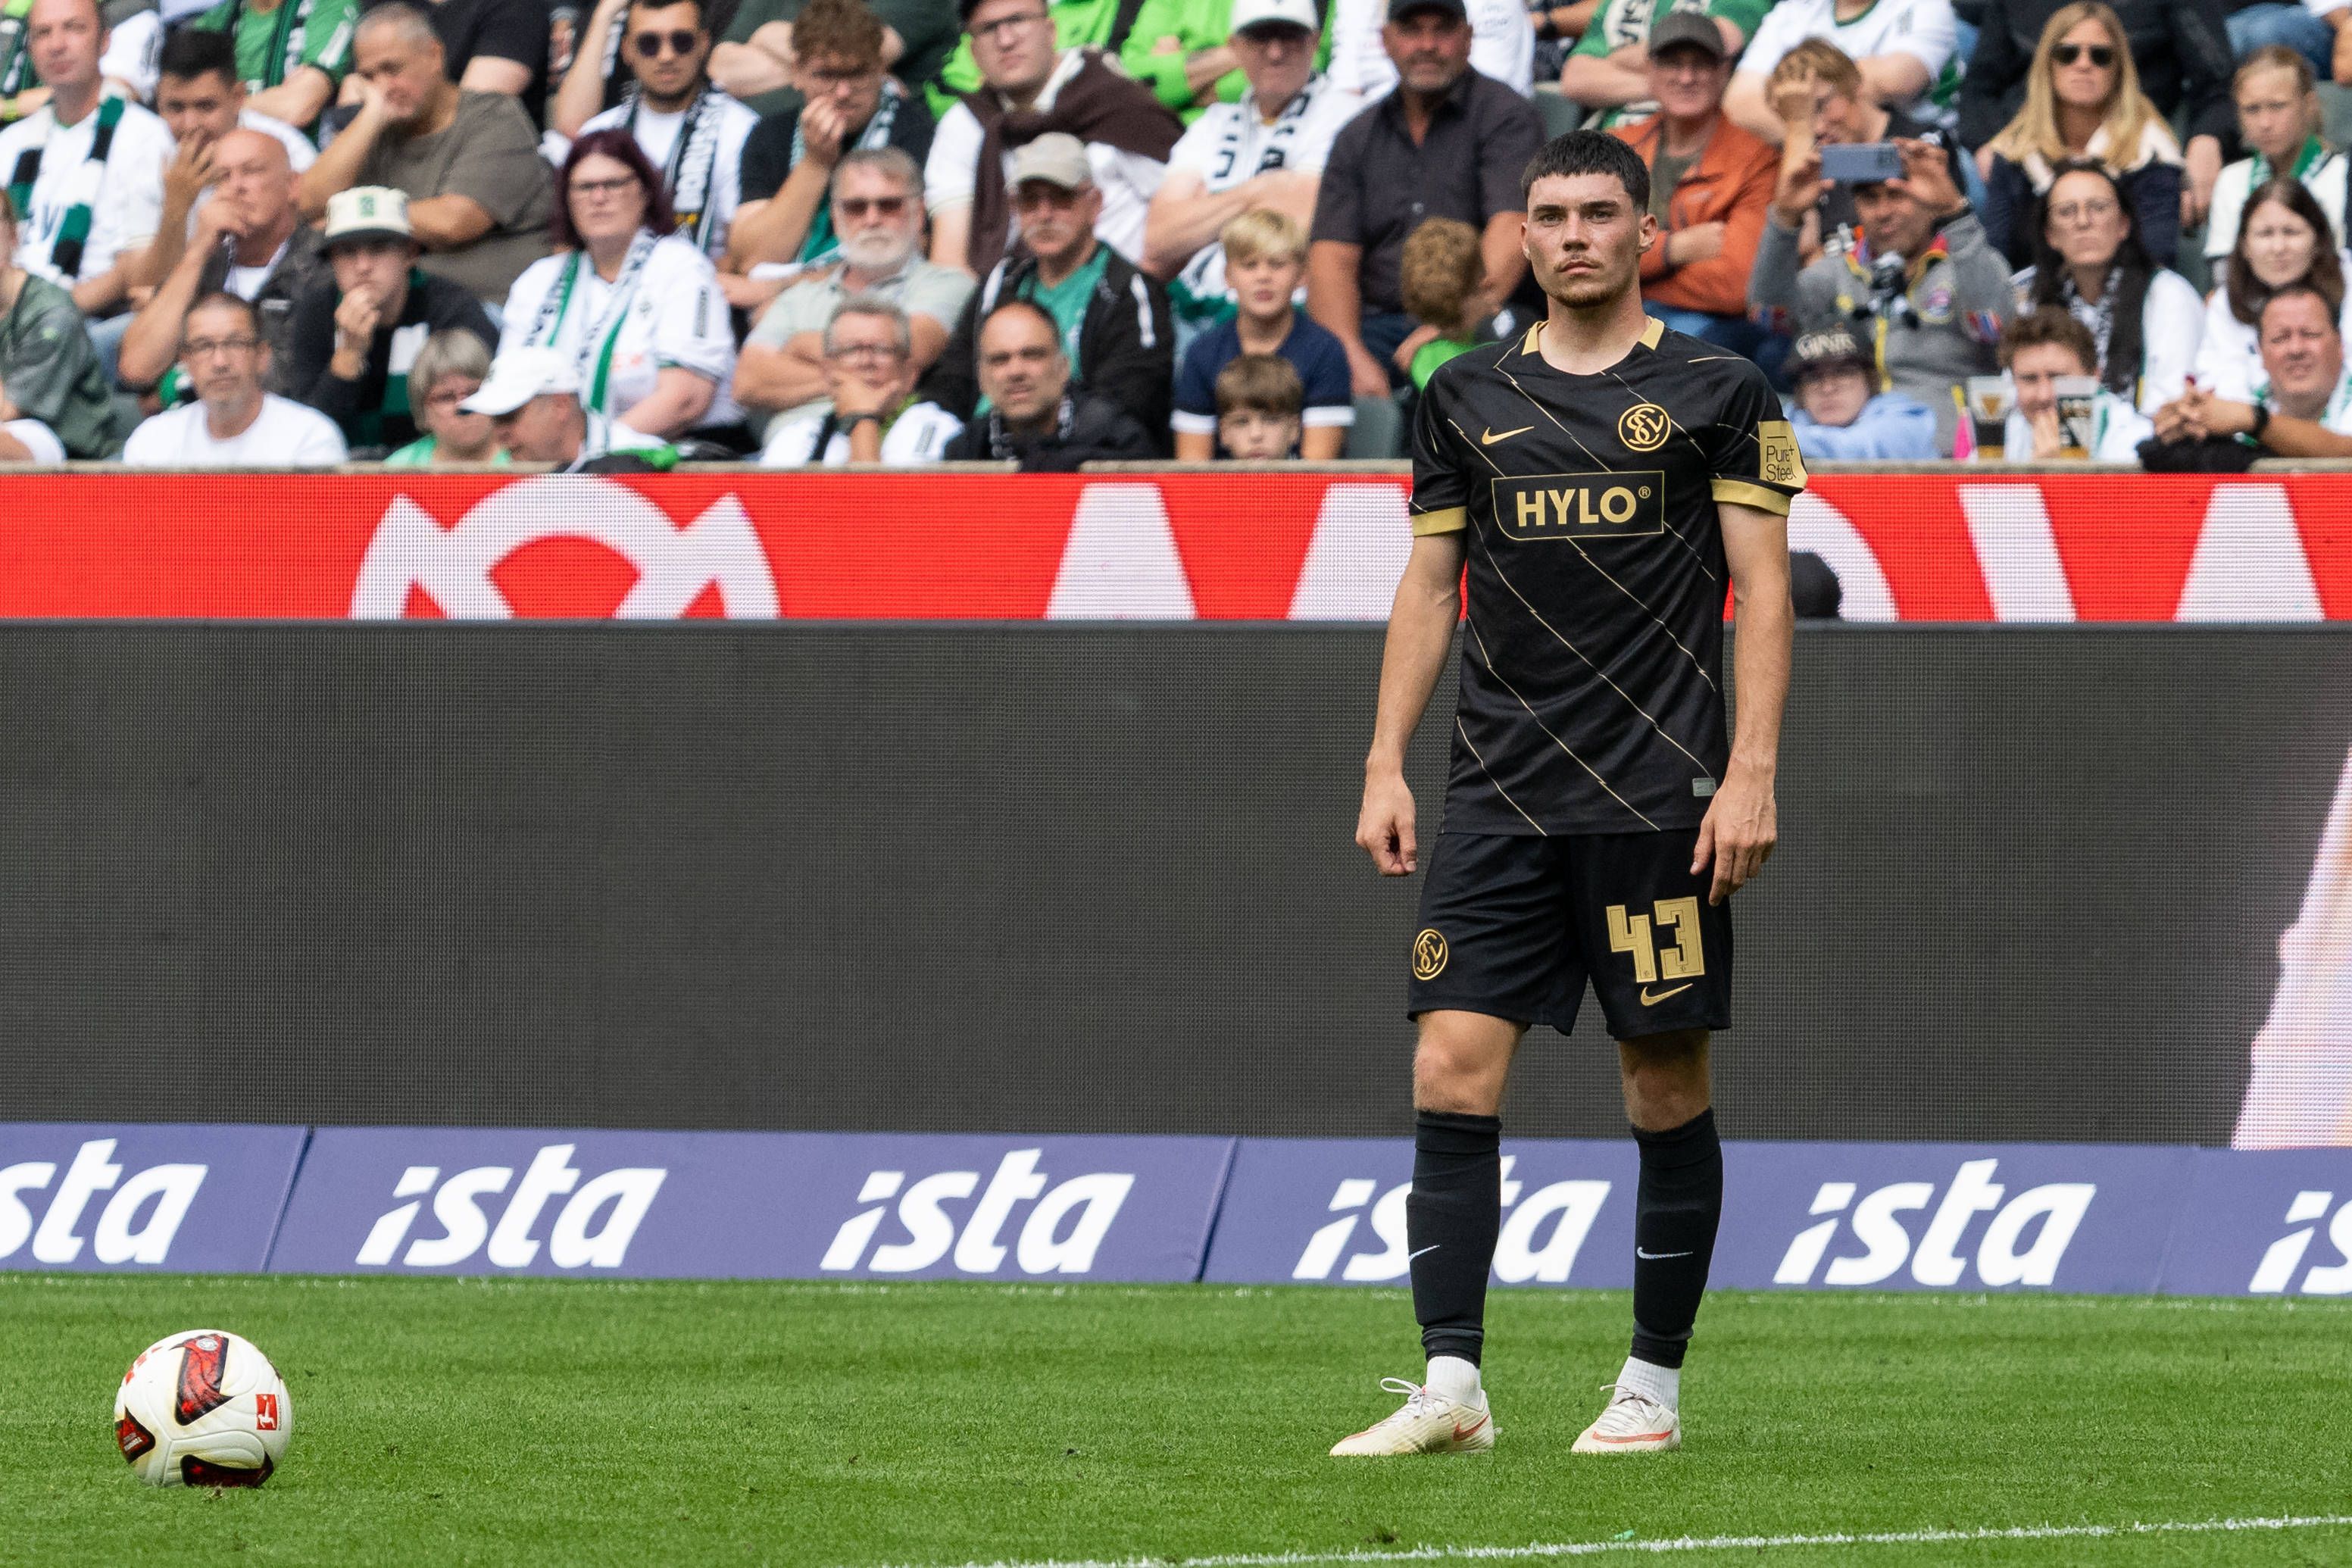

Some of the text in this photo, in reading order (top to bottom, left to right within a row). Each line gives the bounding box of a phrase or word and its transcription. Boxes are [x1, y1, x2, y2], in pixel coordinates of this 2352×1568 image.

[1766, 463, 1797, 482] Steel
[1606, 896, 1705, 983] 43
[355, 1143, 667, 1269] ista
[819, 1148, 1135, 1274] ista
[1292, 1155, 1612, 1282] isa
[1773, 1158, 2097, 1286] ista
